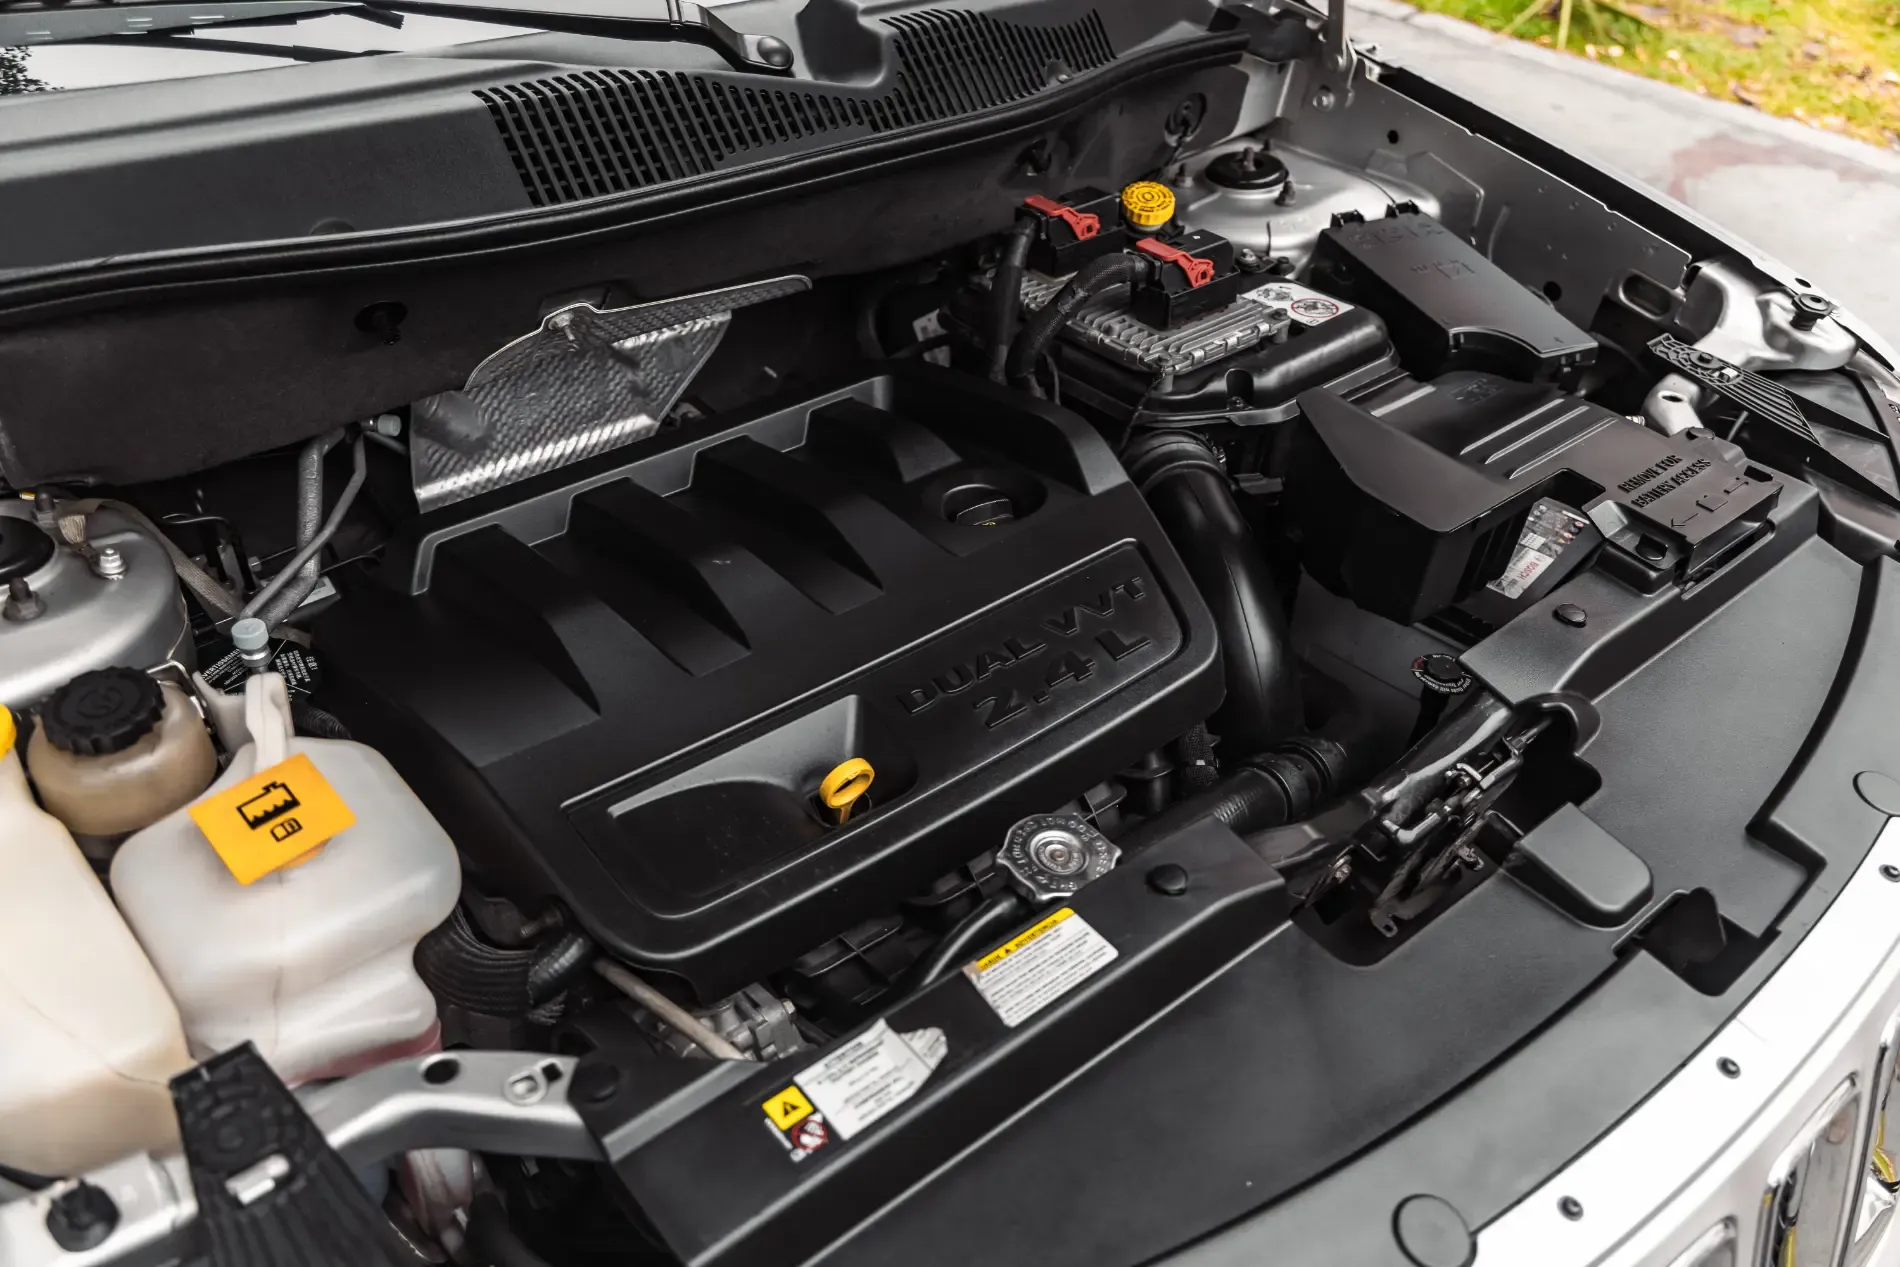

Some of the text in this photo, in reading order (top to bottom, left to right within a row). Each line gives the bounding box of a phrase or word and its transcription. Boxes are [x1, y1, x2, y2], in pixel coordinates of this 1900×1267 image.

[1617, 454, 1683, 494] REMOVE FOR
[1631, 458, 1711, 508] BATTERY ACCESS
[202, 648, 241, 680] VERTISSEME
[897, 575, 1145, 716] DUAL VVT
